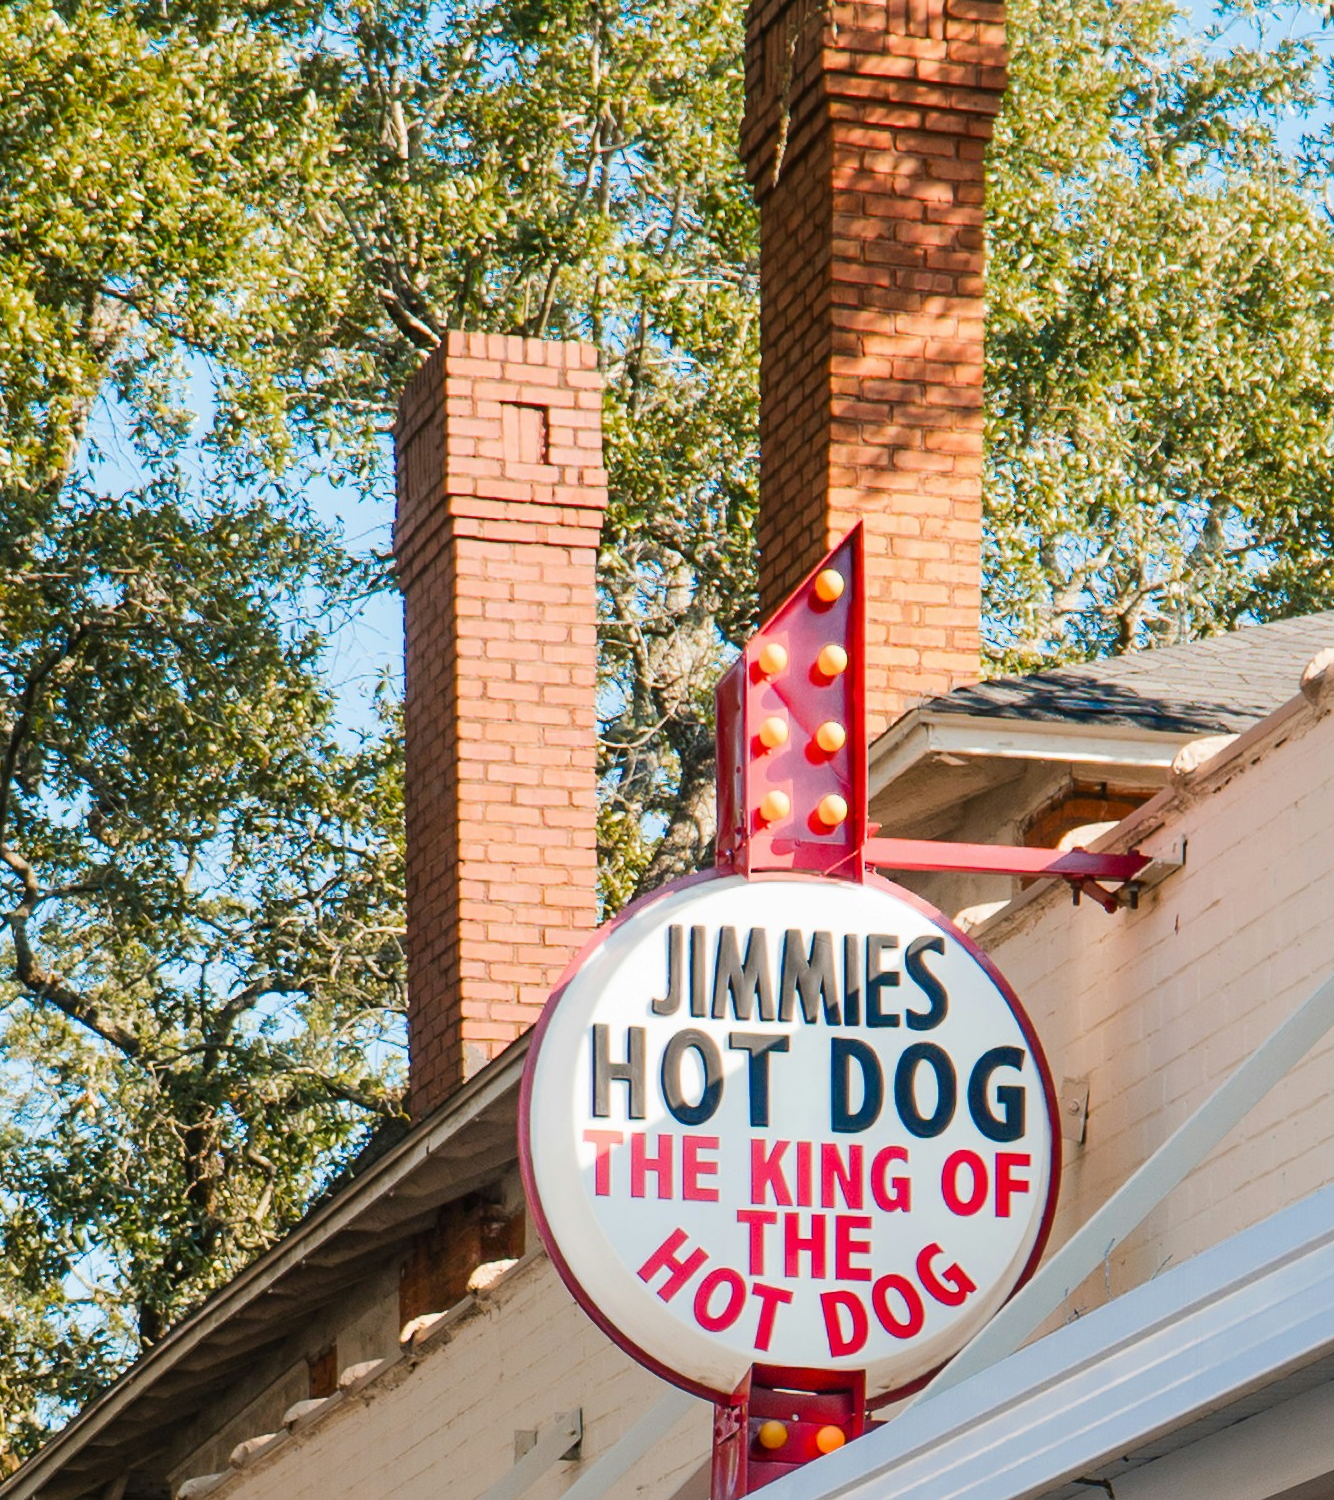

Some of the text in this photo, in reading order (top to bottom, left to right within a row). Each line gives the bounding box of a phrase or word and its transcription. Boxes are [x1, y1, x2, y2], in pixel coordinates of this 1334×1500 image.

[651, 923, 948, 1032] JIMMIES
[591, 1023, 1026, 1143] HOT DOG
[583, 1129, 1032, 1219] THE KING OF
[637, 1226, 977, 1358] HOT DOG
[736, 1208, 872, 1282] THE
